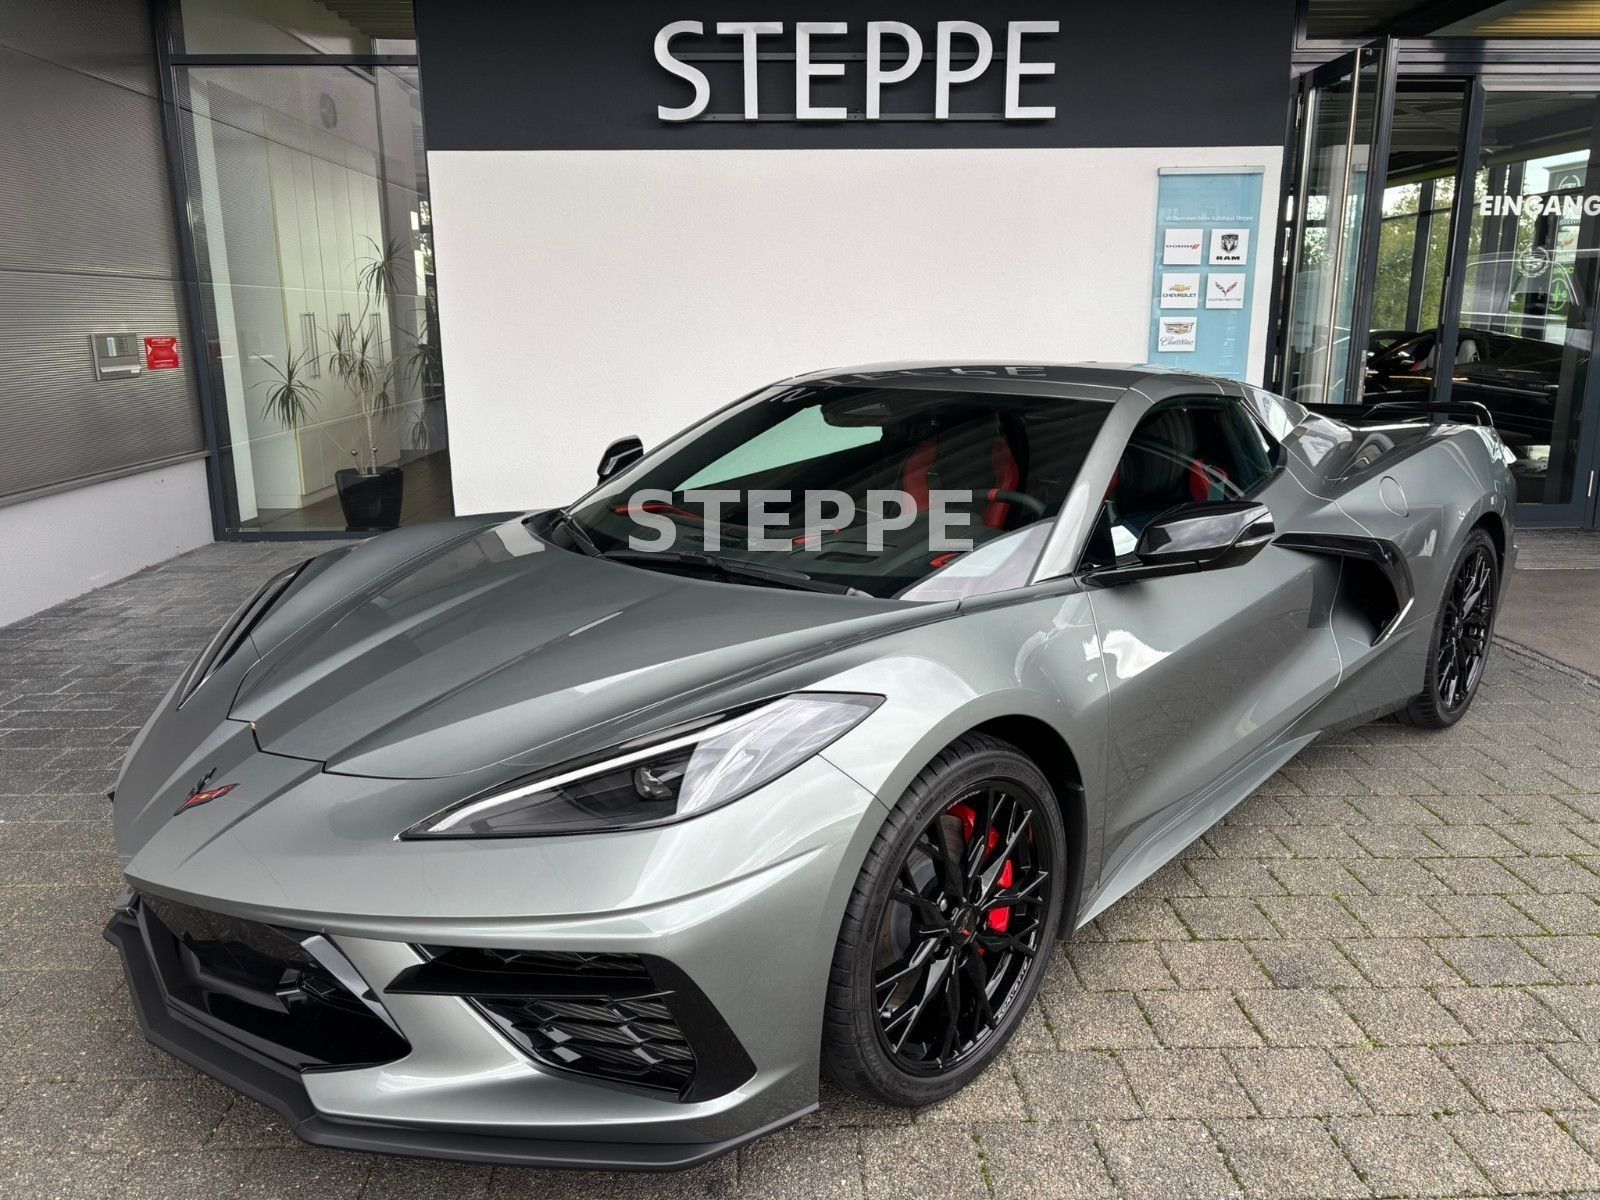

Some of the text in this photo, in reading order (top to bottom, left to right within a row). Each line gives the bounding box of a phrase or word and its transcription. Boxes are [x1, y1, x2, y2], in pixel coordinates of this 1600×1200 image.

[653, 20, 1060, 121] STEPPE
[1479, 194, 1600, 216] EINGANG
[1160, 336, 1194, 347] Cadillac
